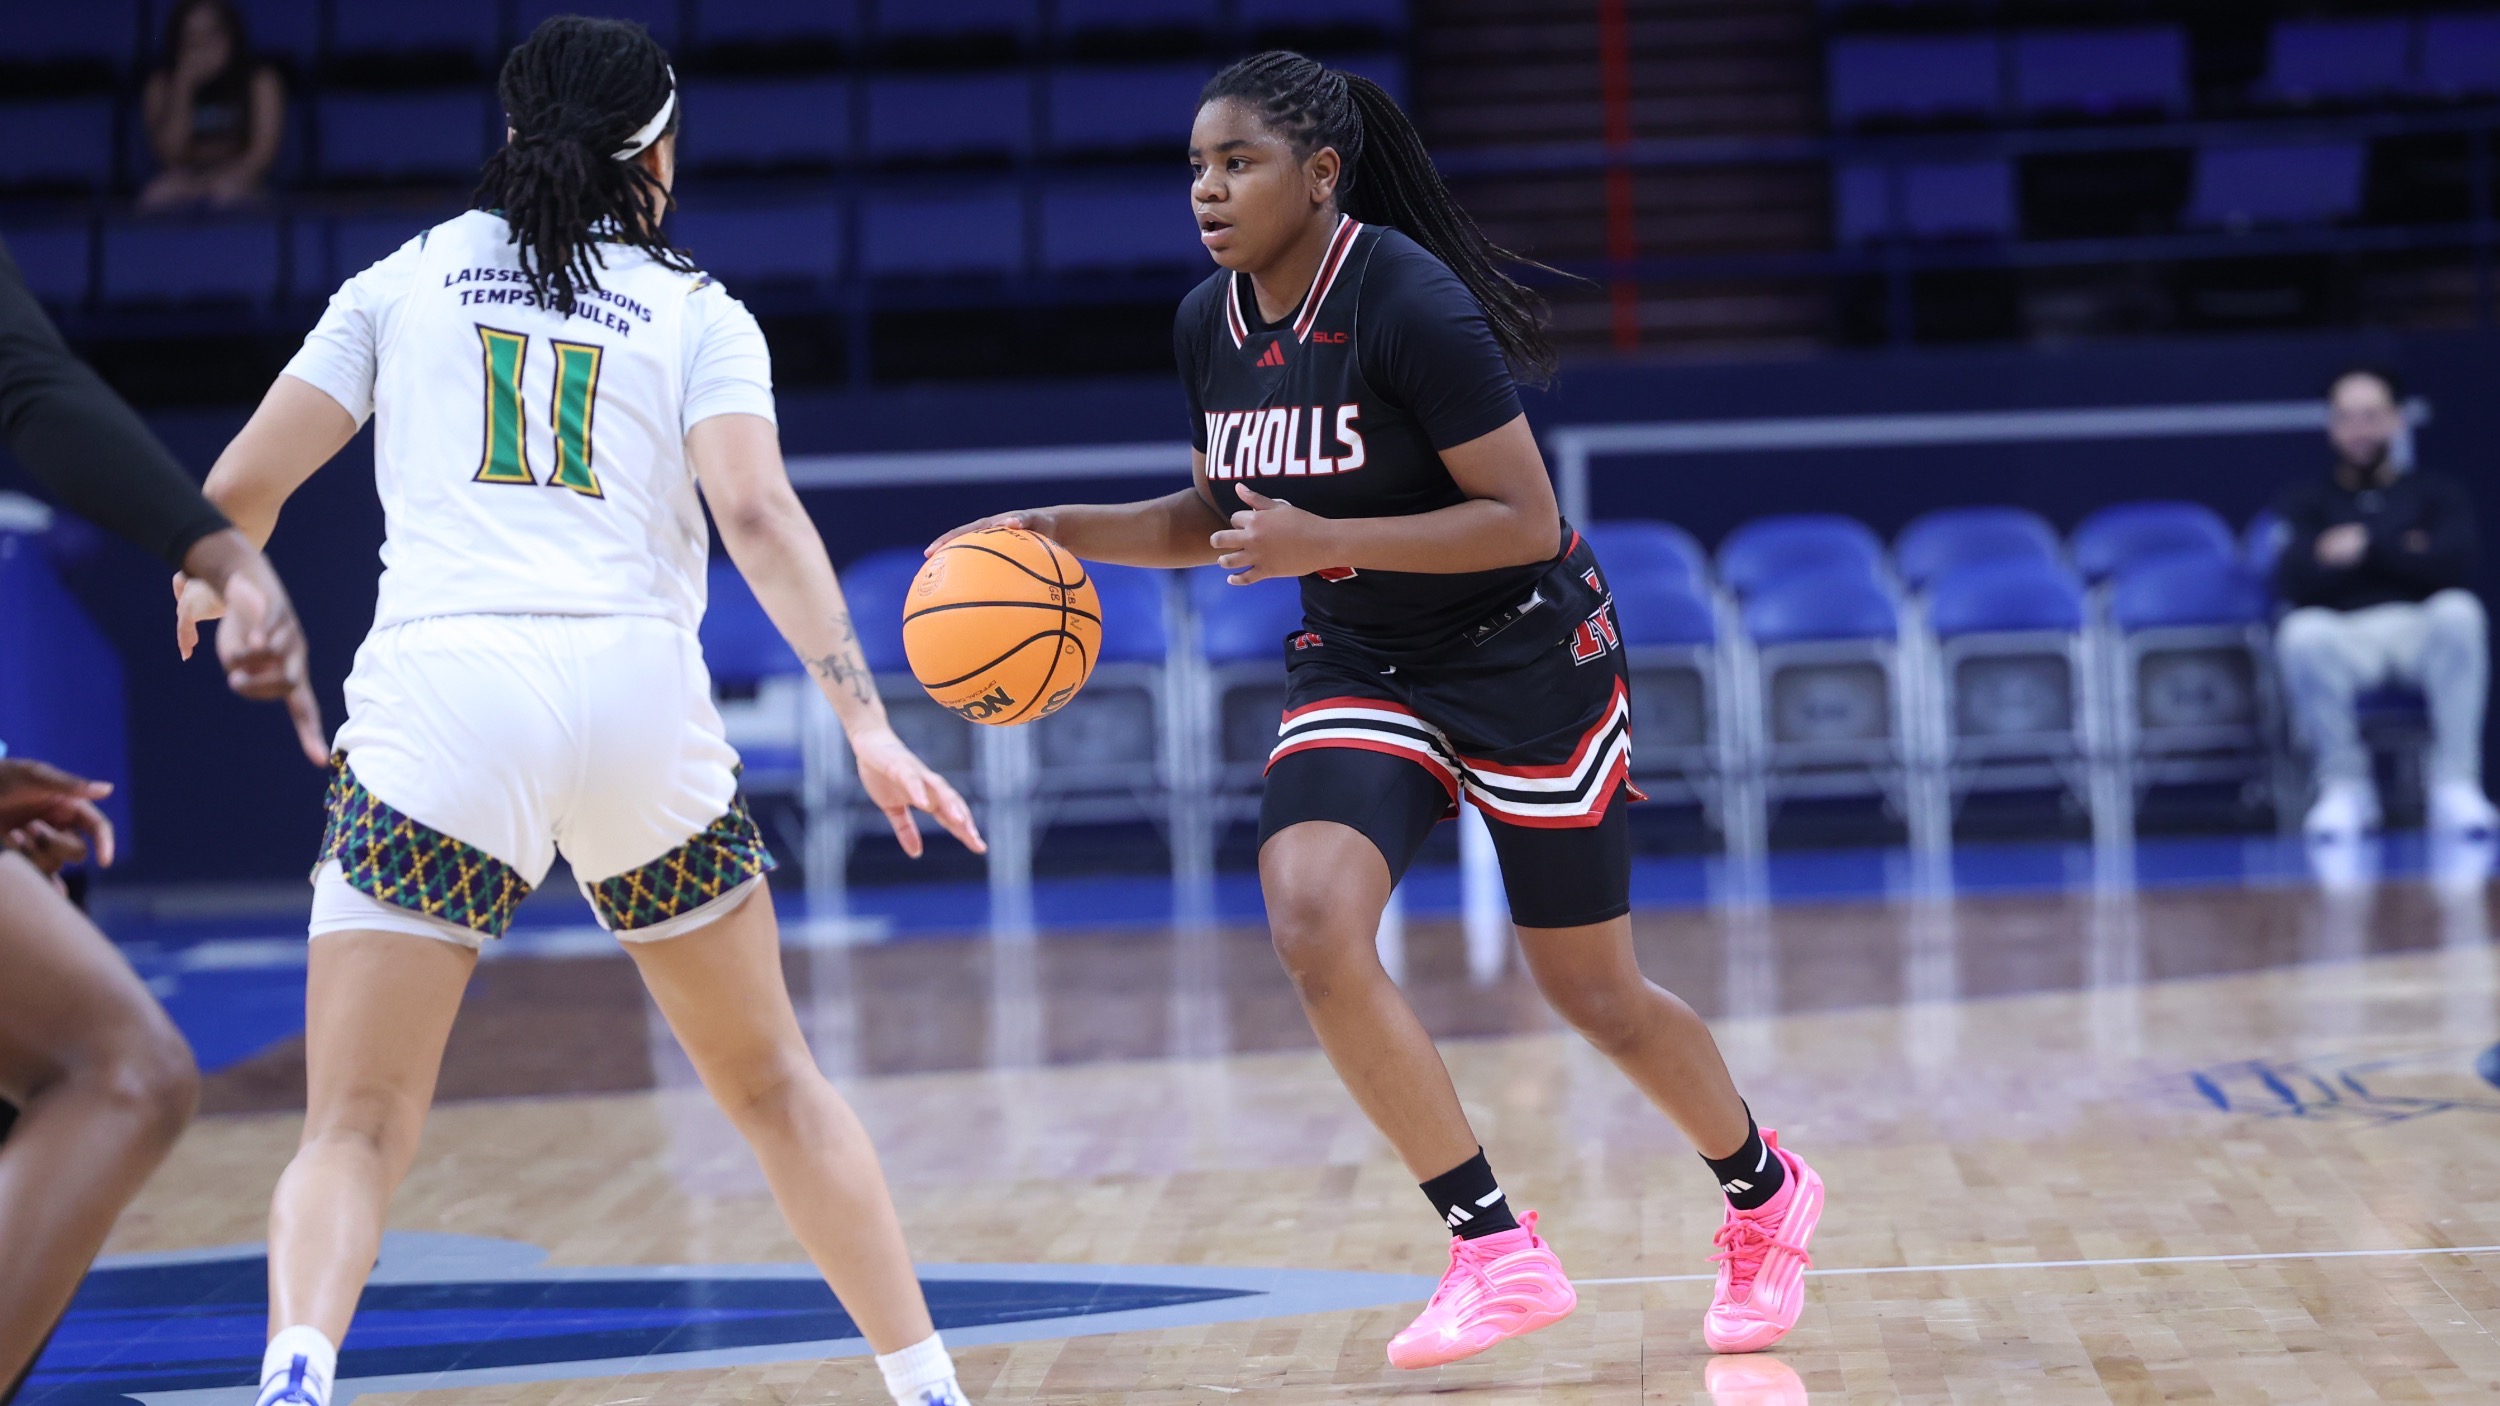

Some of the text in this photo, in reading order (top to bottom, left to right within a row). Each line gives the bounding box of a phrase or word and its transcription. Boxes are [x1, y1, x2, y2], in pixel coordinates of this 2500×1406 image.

[443, 267, 531, 288] LAISSE
[598, 289, 653, 323] BONS
[460, 289, 536, 307] TEMPS
[472, 322, 606, 500] 11
